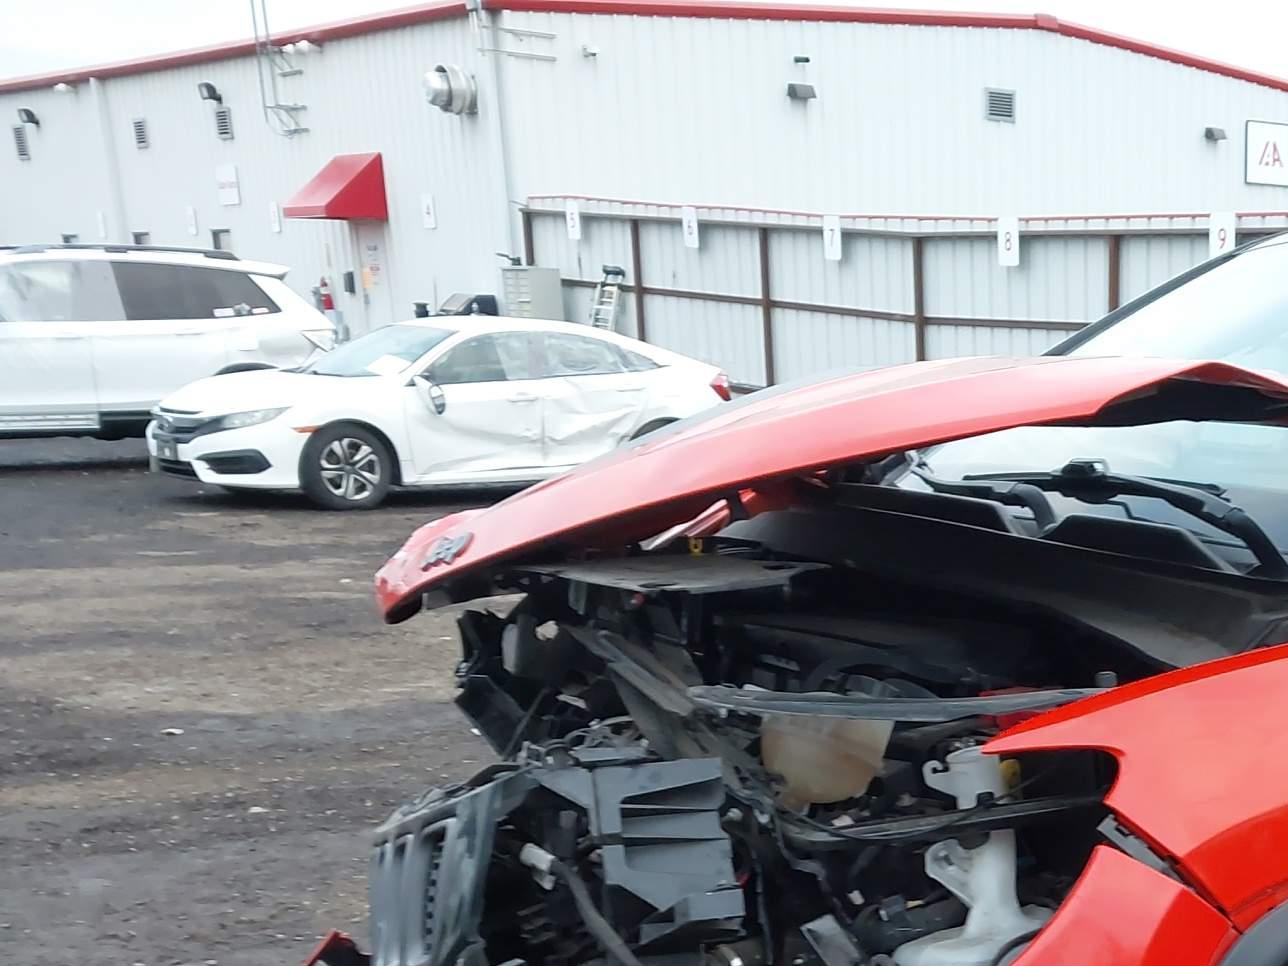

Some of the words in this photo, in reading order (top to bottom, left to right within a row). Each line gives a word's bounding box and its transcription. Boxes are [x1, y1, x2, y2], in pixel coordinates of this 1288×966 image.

[828, 228, 836, 248] 7
[1004, 231, 1012, 251] 8
[1218, 228, 1227, 249] 9
